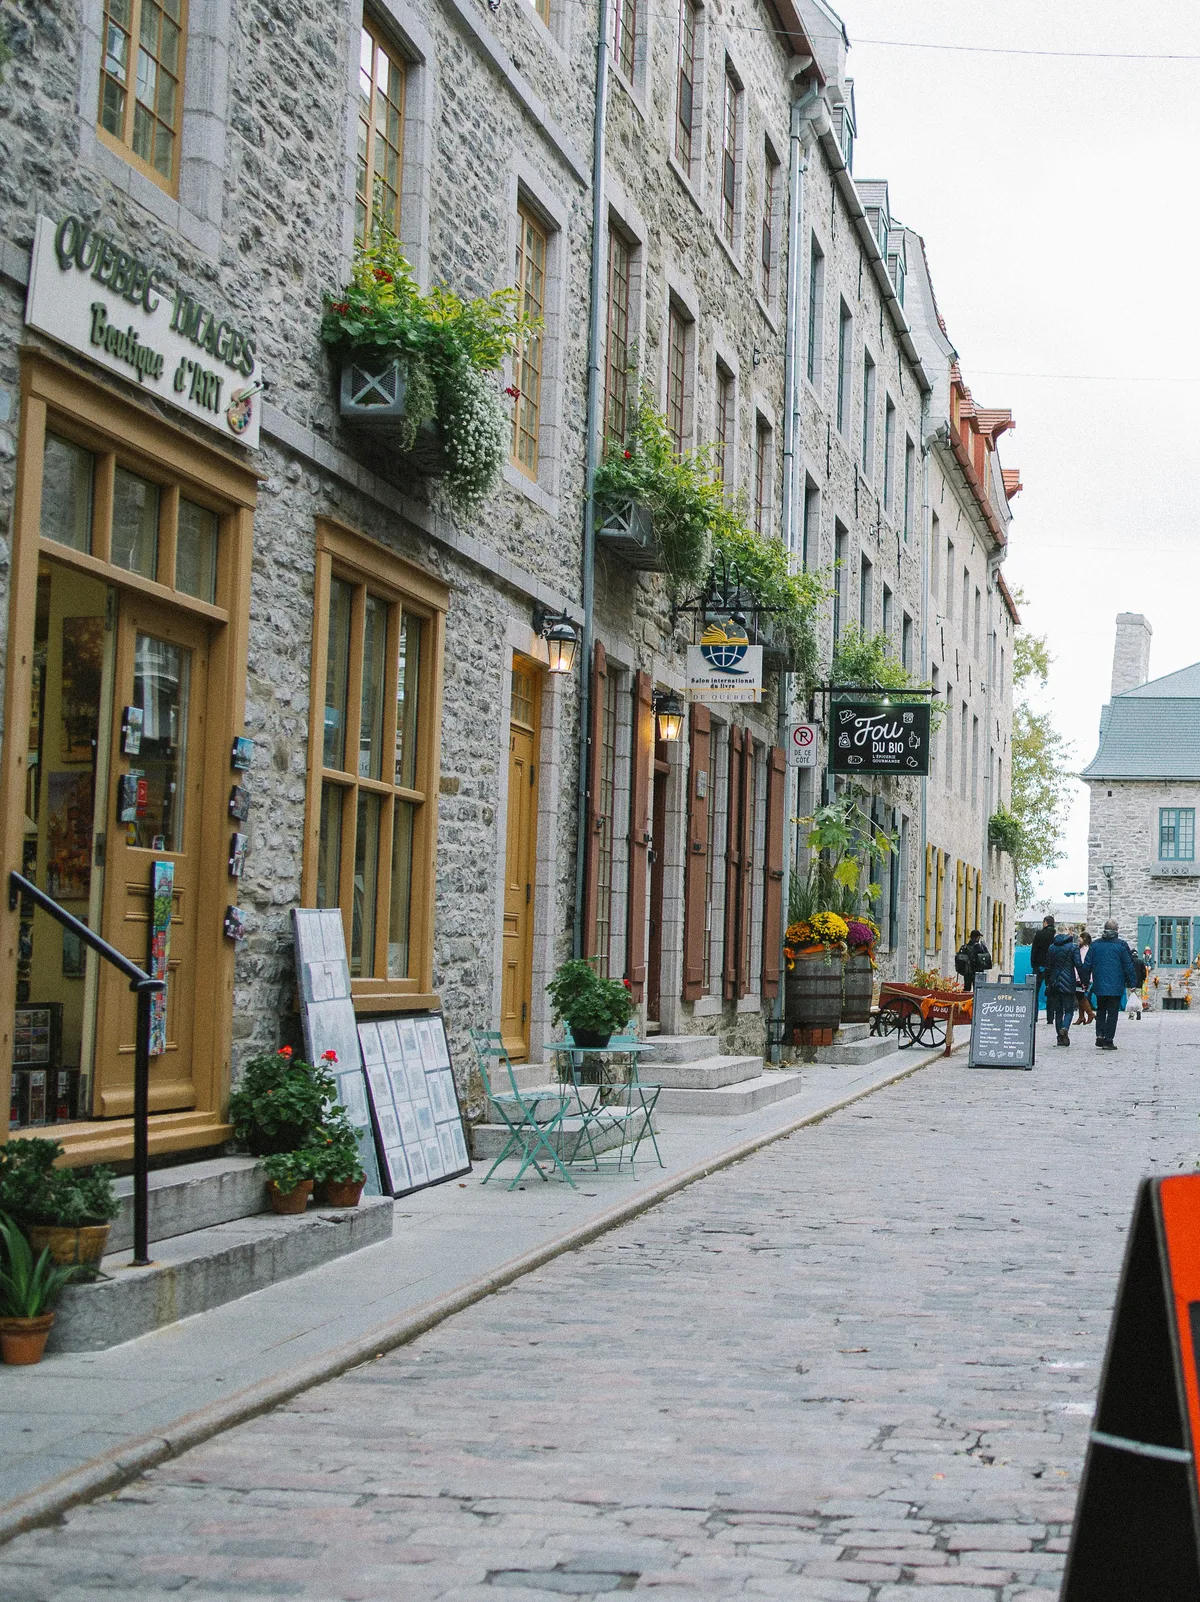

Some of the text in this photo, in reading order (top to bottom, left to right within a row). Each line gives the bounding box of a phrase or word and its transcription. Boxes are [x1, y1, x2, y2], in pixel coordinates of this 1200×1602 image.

[169, 288, 258, 377] IMAGES
[90, 301, 224, 414] Boutique d'ART
[854, 713, 904, 746] Fou
[872, 742, 904, 754] DU BIO
[982, 1001, 1027, 1015] Fou DU BIO
